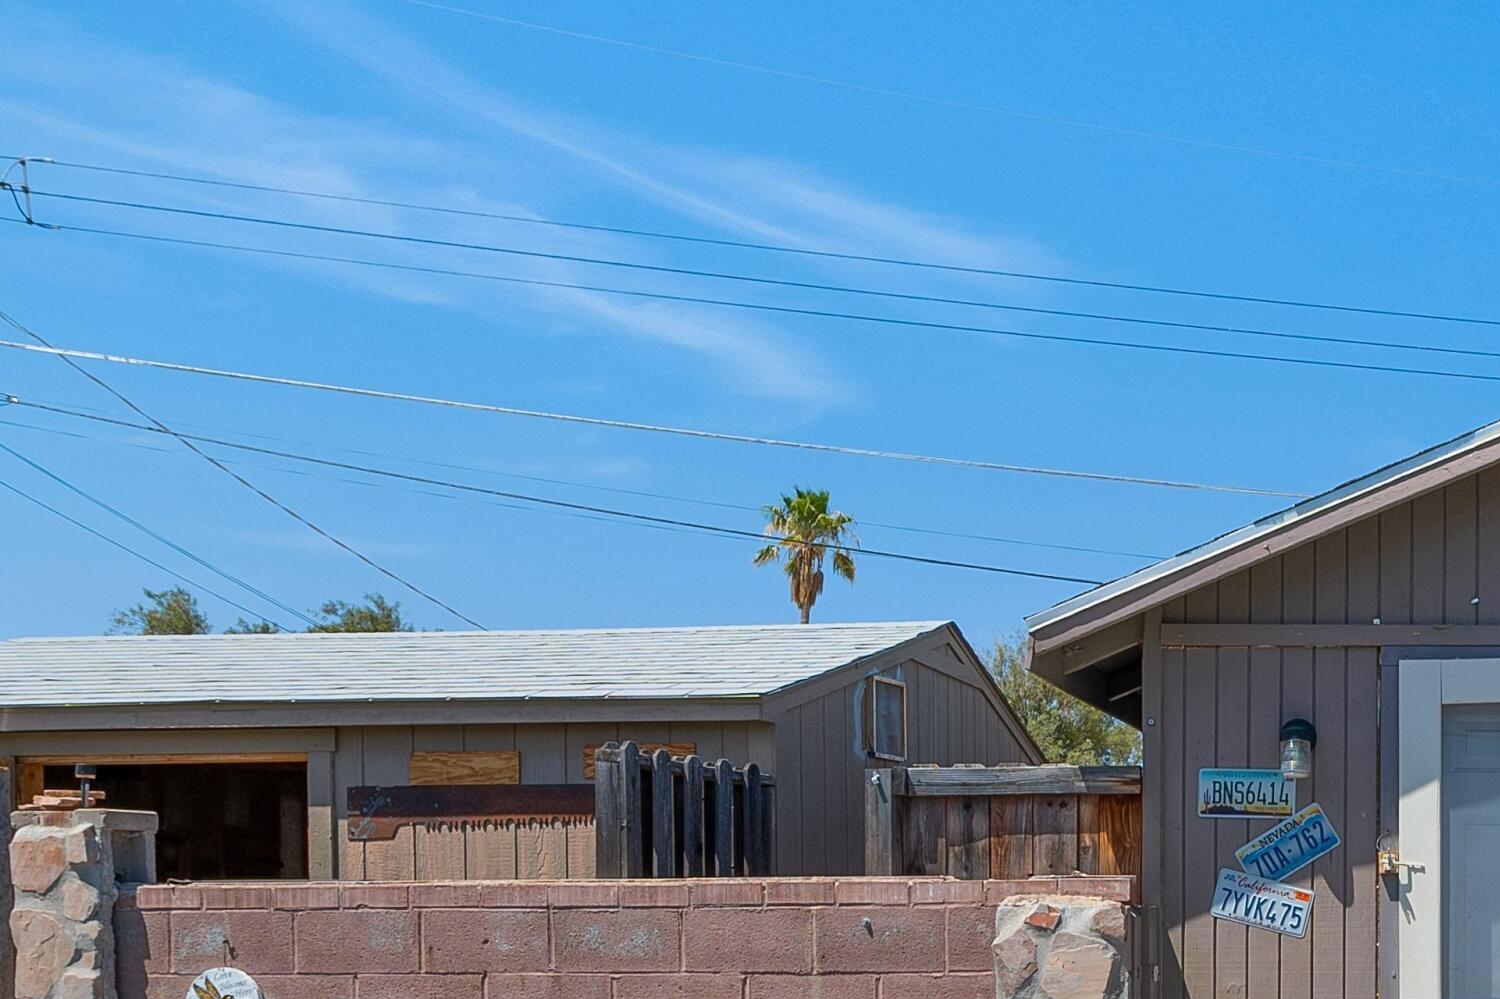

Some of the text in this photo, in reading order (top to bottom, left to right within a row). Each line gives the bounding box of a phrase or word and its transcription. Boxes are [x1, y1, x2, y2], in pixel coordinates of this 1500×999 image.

[1211, 780, 1289, 806] BNS6414
[1258, 818, 1300, 848] NEVADA
[1238, 876, 1292, 898] California
[1221, 887, 1304, 930] 7YVK475
